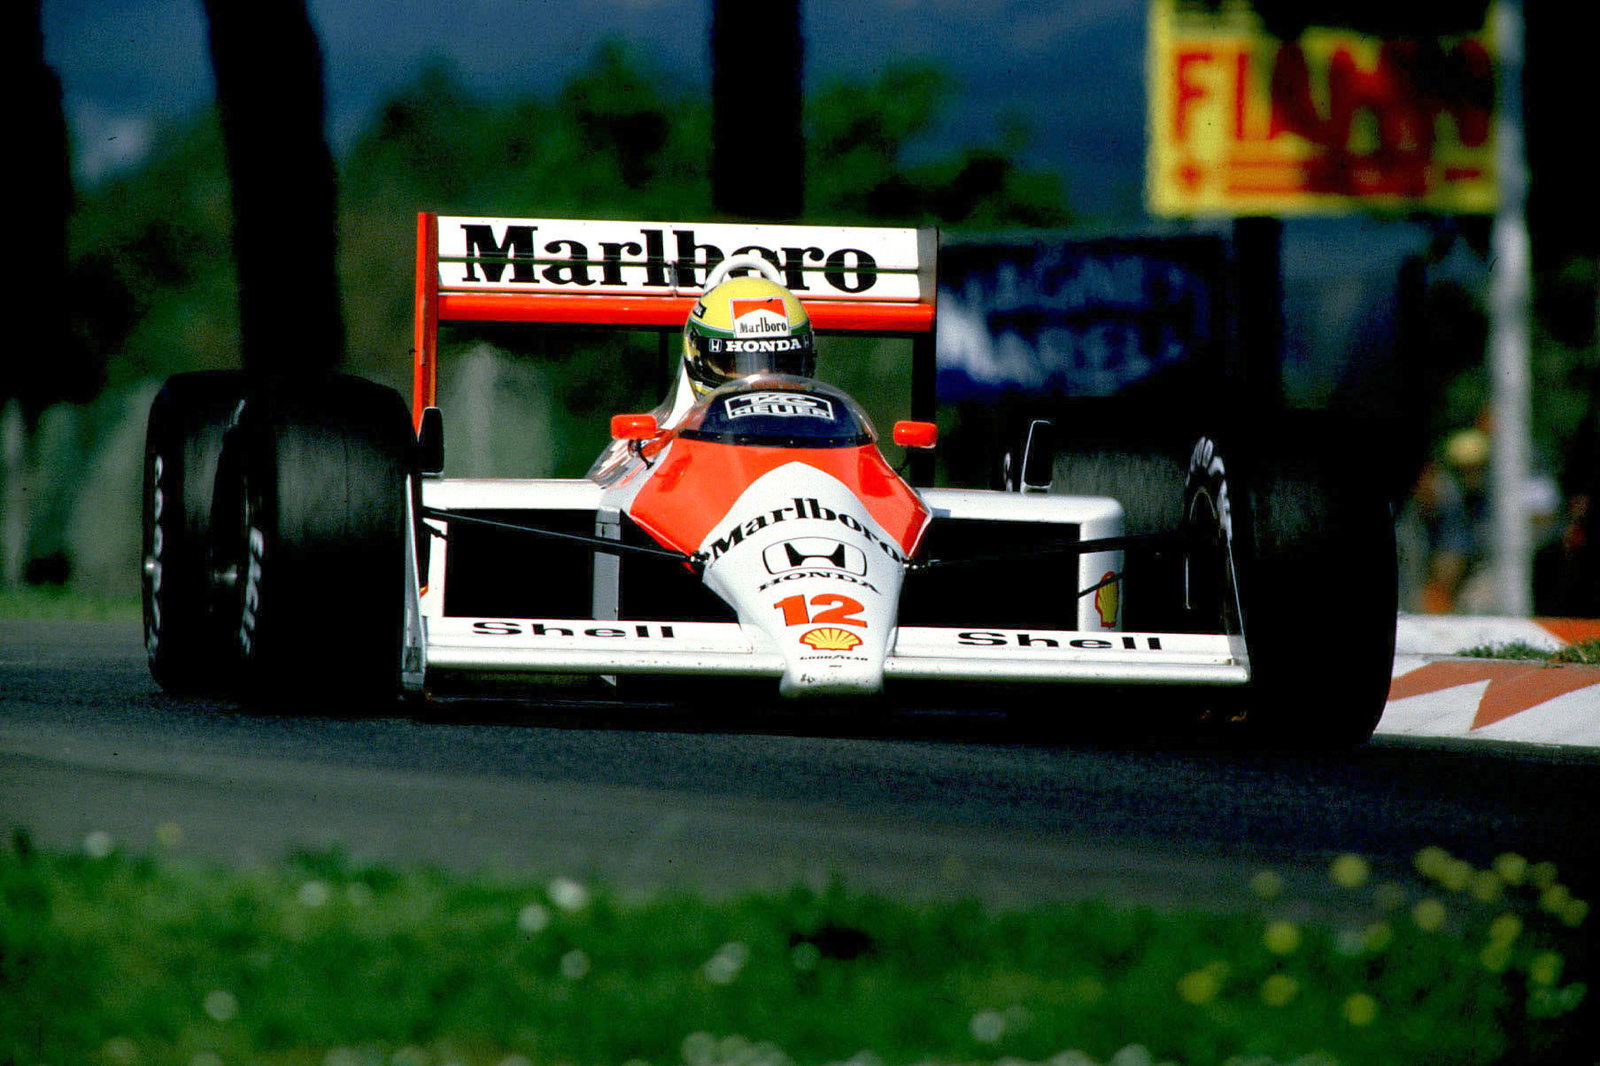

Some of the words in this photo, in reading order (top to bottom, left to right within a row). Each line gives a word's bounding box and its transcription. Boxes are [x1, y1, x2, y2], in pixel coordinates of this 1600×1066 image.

[739, 317, 787, 334] Marlboro
[725, 339, 802, 353] HONDA
[708, 497, 901, 568] Marlboro
[758, 571, 882, 596] HONDA
[773, 593, 868, 628] 12
[472, 621, 675, 639] Shell
[957, 631, 1163, 651] Shell
